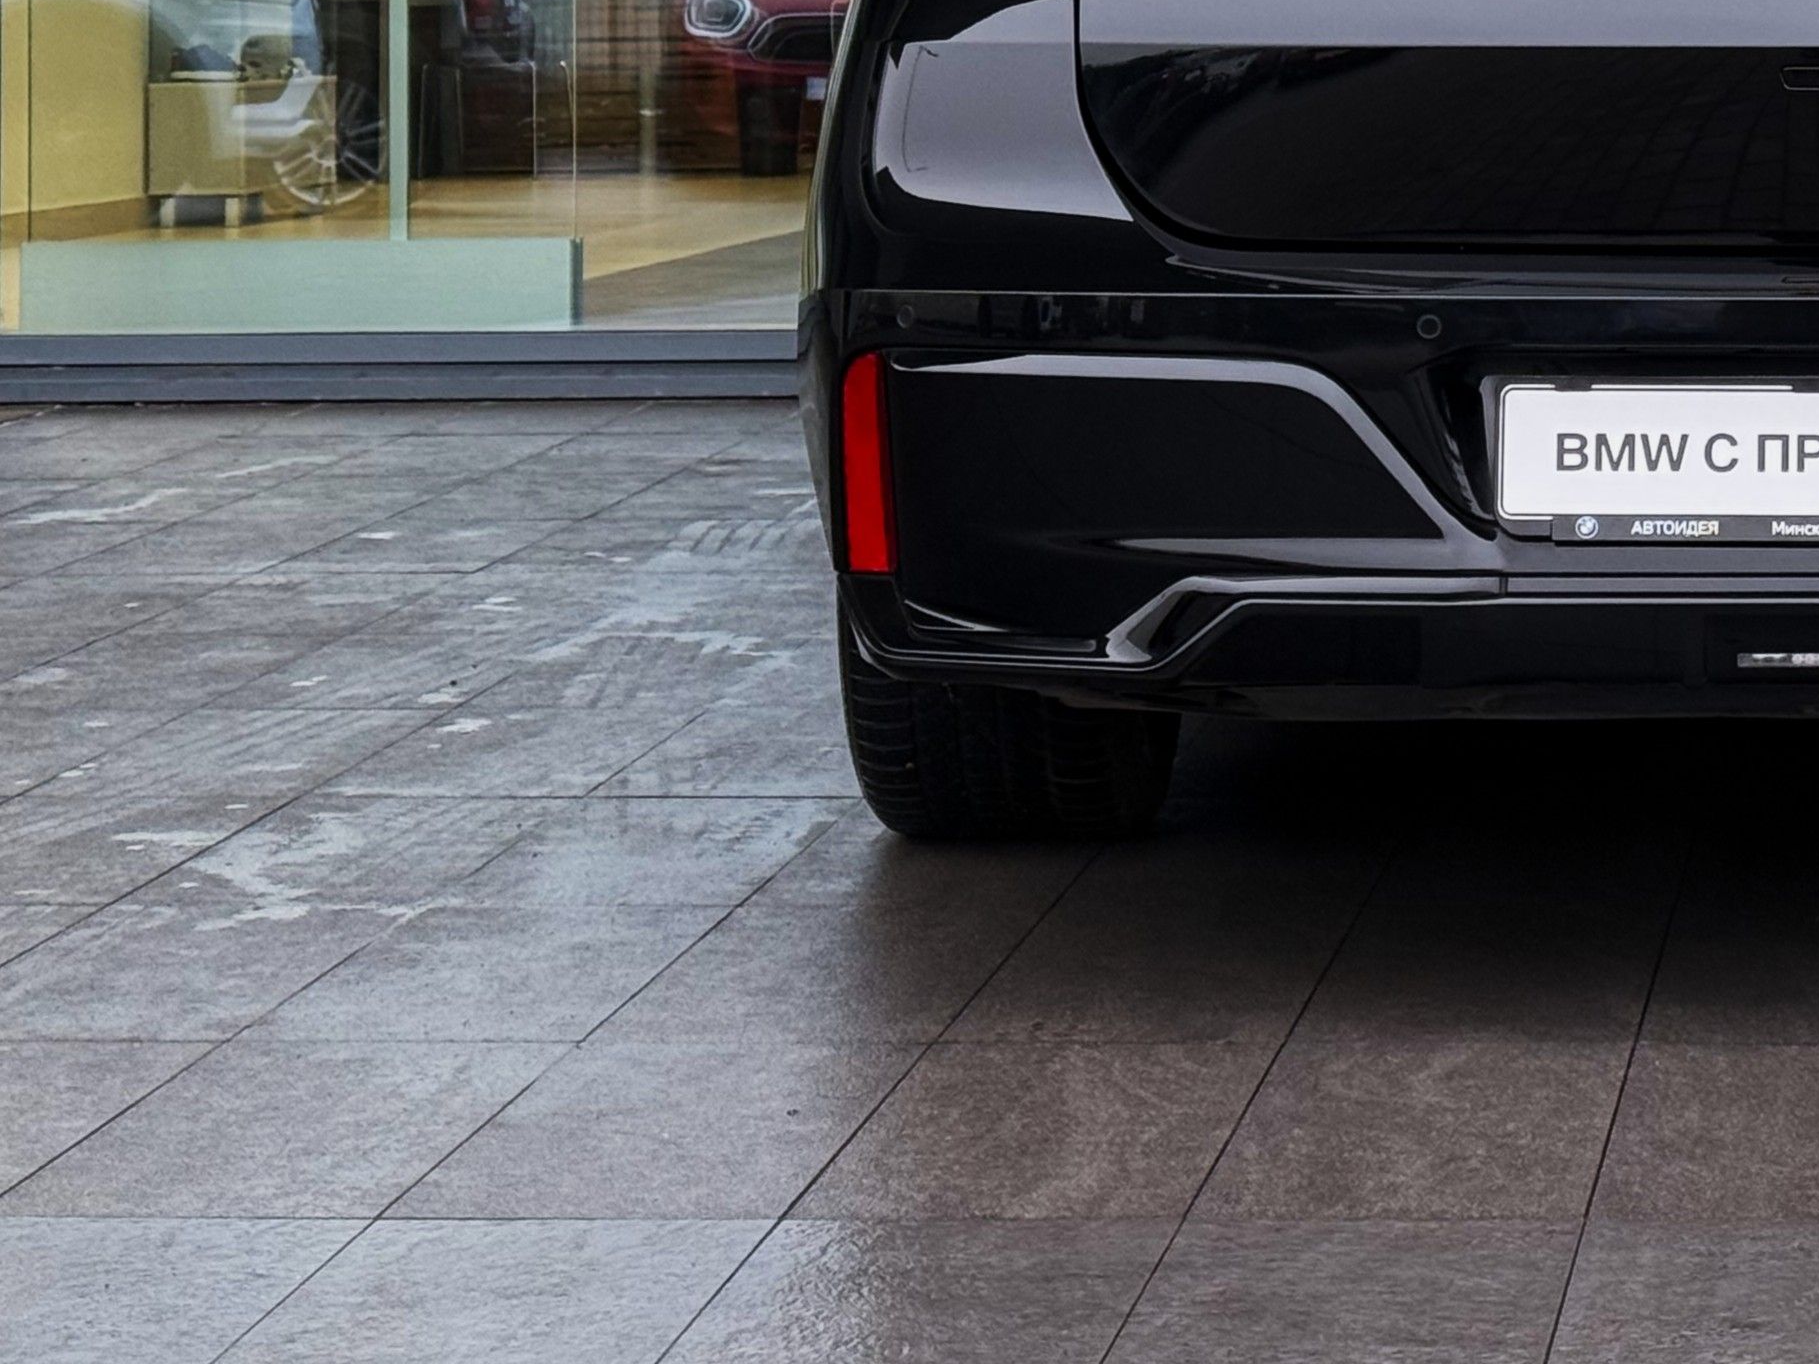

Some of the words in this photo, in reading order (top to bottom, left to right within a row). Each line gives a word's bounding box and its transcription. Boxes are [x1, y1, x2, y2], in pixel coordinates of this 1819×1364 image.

[1555, 432, 1689, 473] BMW
[1704, 433, 1739, 473] С
[1630, 520, 1720, 538] АВТОИДЕЯ
